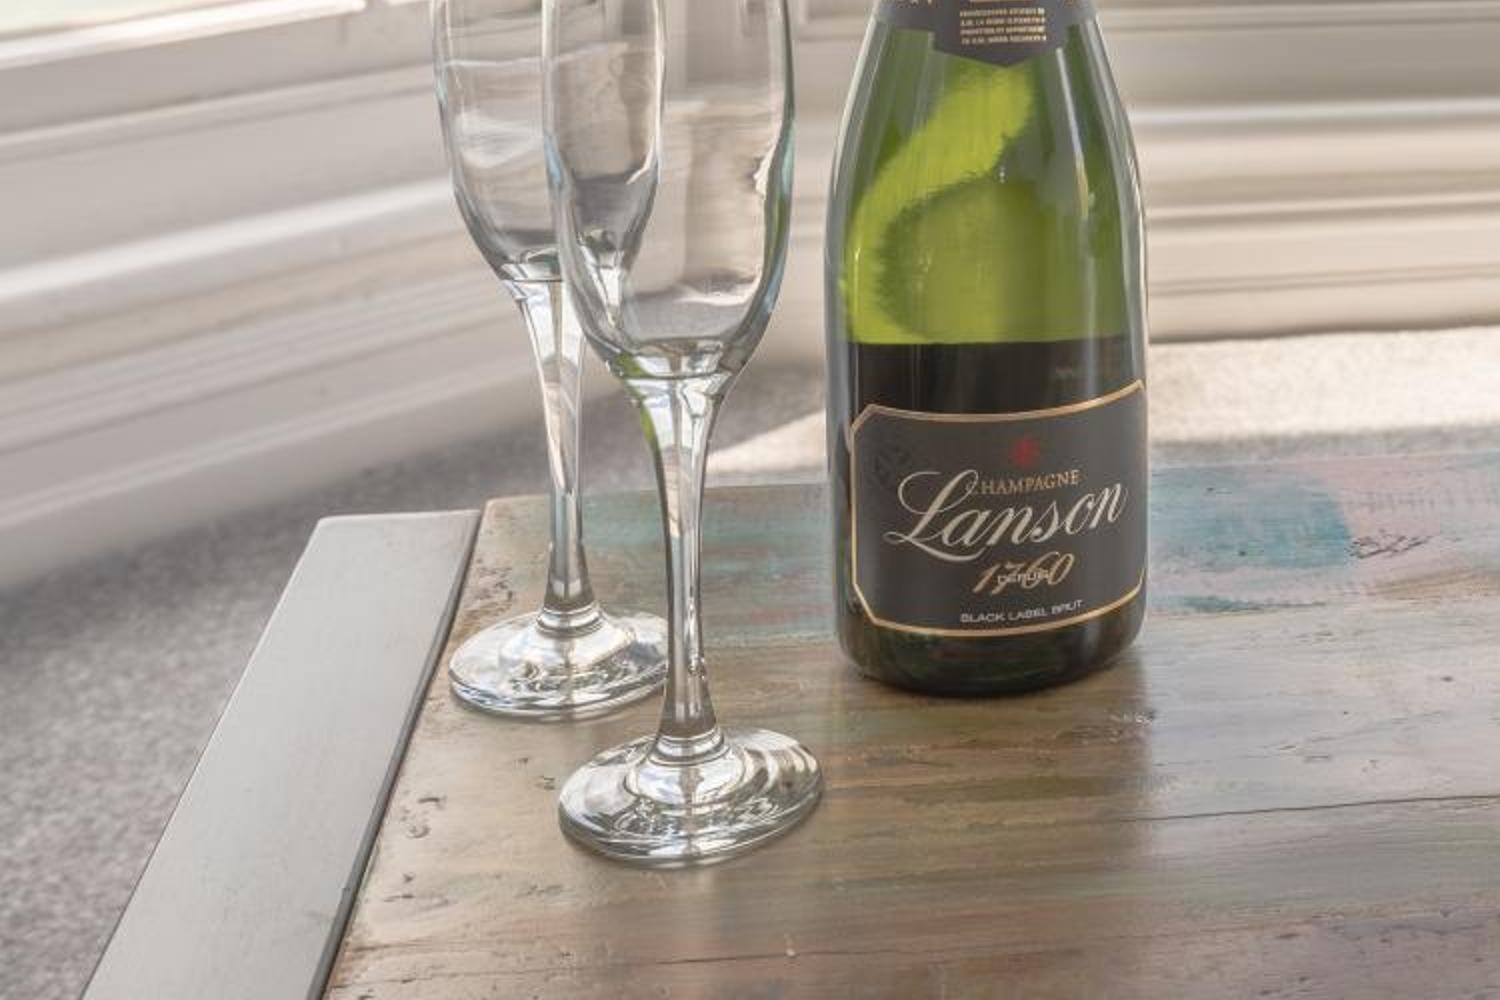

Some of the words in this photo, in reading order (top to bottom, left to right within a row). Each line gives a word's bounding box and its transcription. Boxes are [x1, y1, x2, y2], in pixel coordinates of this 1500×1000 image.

[965, 470, 1081, 497] CHAMPAGNE
[884, 469, 1129, 562] Lanson
[972, 551, 1075, 595] 1760
[961, 612, 1005, 623] BLACK
[1008, 607, 1049, 621] LABEL
[1051, 599, 1084, 615] BRUT
